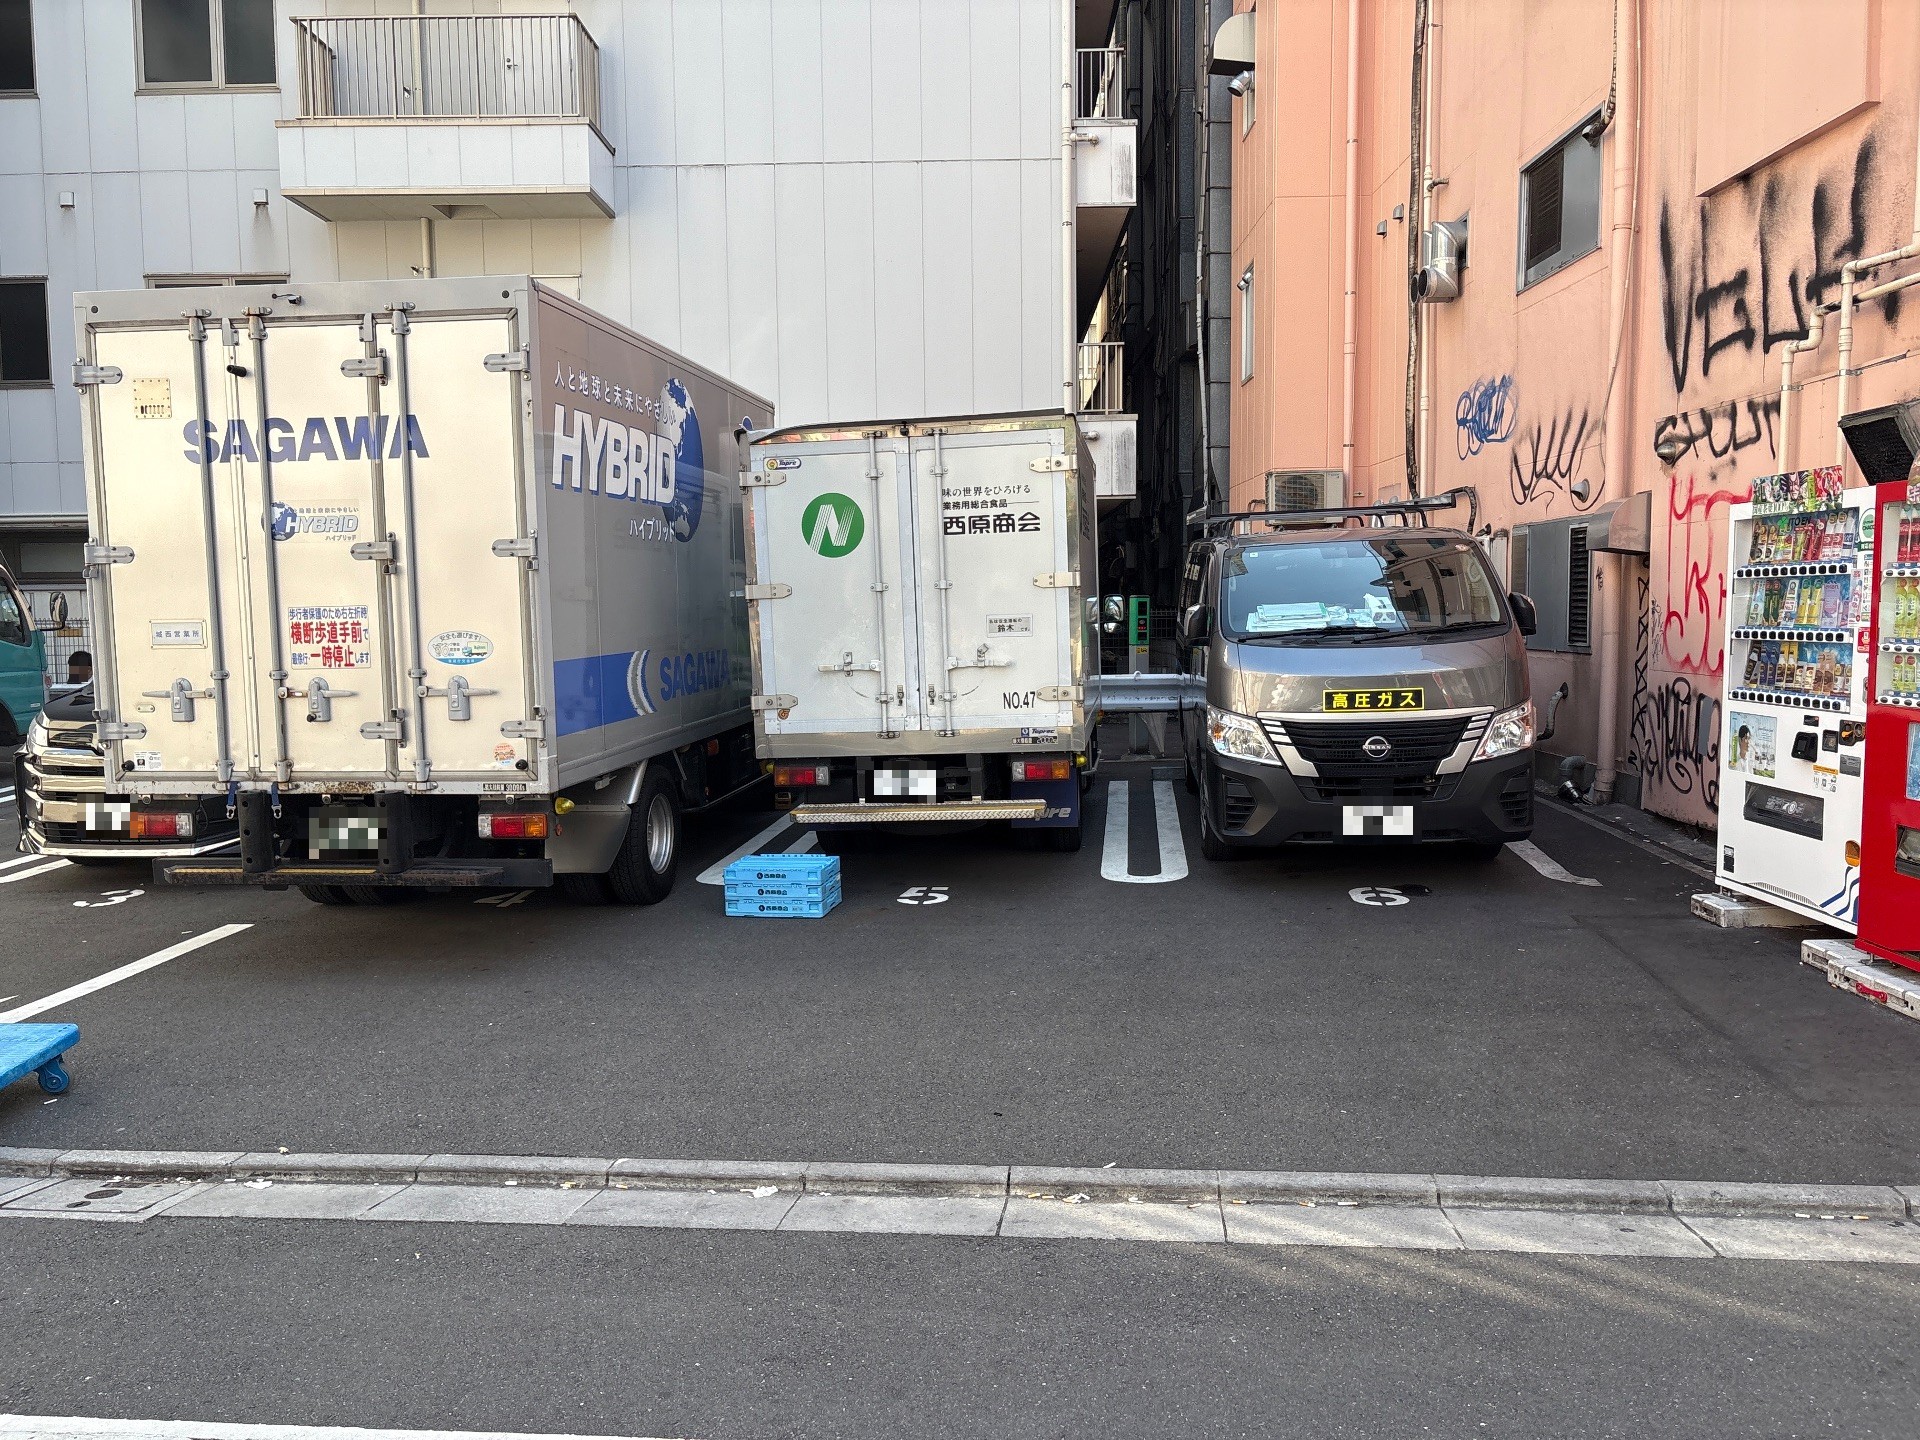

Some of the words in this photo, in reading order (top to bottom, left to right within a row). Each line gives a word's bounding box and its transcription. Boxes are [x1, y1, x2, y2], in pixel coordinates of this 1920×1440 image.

[183, 415, 430, 464] SAGAWA
[552, 403, 675, 506] HYBRID
[942, 485, 1031, 497] 味の世界をひろげる
[943, 499, 1008, 510] 業務用総合食品
[285, 515, 359, 533] HYBRID
[630, 517, 675, 542] ハイブリッド
[943, 511, 1041, 536] 西原商会
[289, 606, 368, 621] 歩行者保護のため右左折時
[291, 620, 369, 645] 横断歩道手前で
[997, 624, 1015, 633] 鈴木
[660, 649, 731, 701] SAGAWA
[1003, 691, 1036, 709] NO.47
[1332, 692, 1416, 708] 高圧ガス
[897, 886, 950, 905] 5
[1348, 887, 1410, 906] 6
